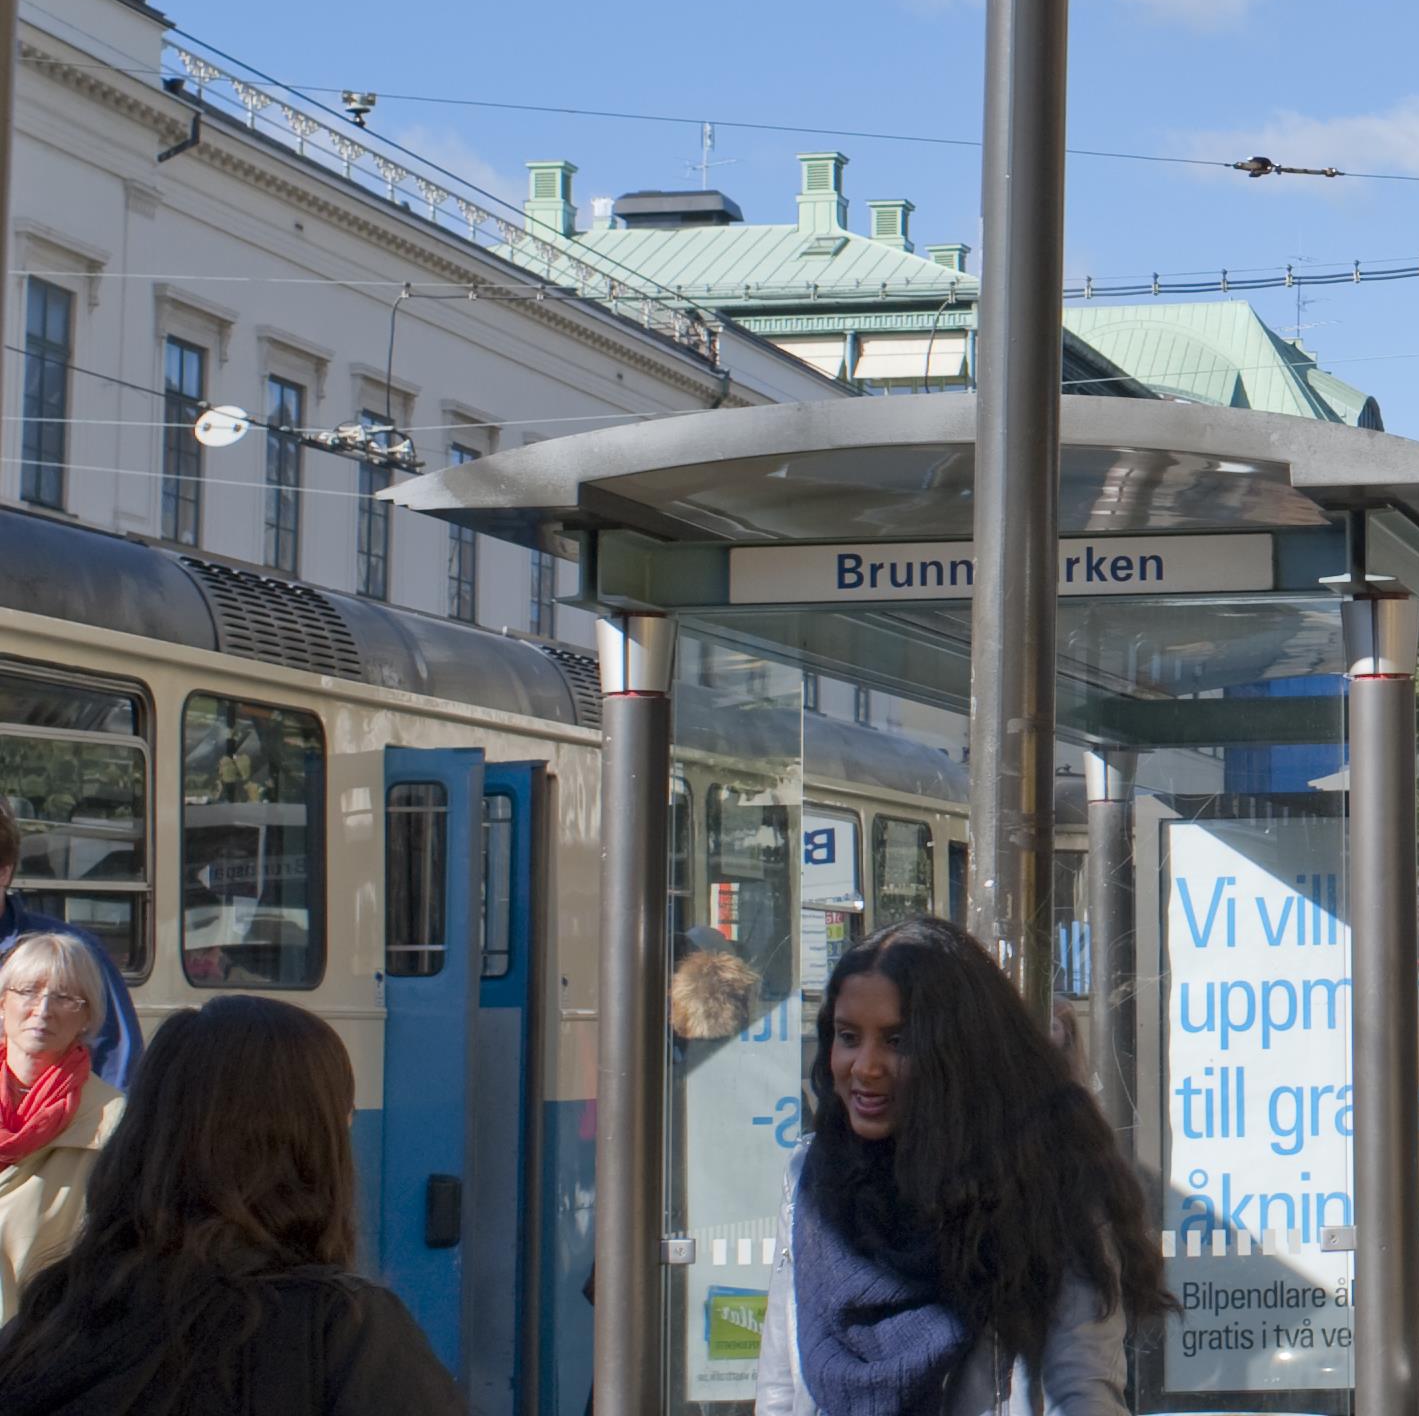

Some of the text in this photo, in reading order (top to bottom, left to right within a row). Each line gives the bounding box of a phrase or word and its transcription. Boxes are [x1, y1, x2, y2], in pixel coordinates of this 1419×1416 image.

[836, 546, 1164, 589] Brunnrken
[1175, 876, 1236, 948] Vi
[1255, 874, 1337, 946] vill
[1175, 1066, 1245, 1139] till
[1180, 1168, 1352, 1245] åknin
[1183, 1281, 1326, 1316] Bilpendlare
[1182, 1322, 1254, 1357] gratis
[1262, 1321, 1267, 1349] i
[1274, 1319, 1314, 1349] två
